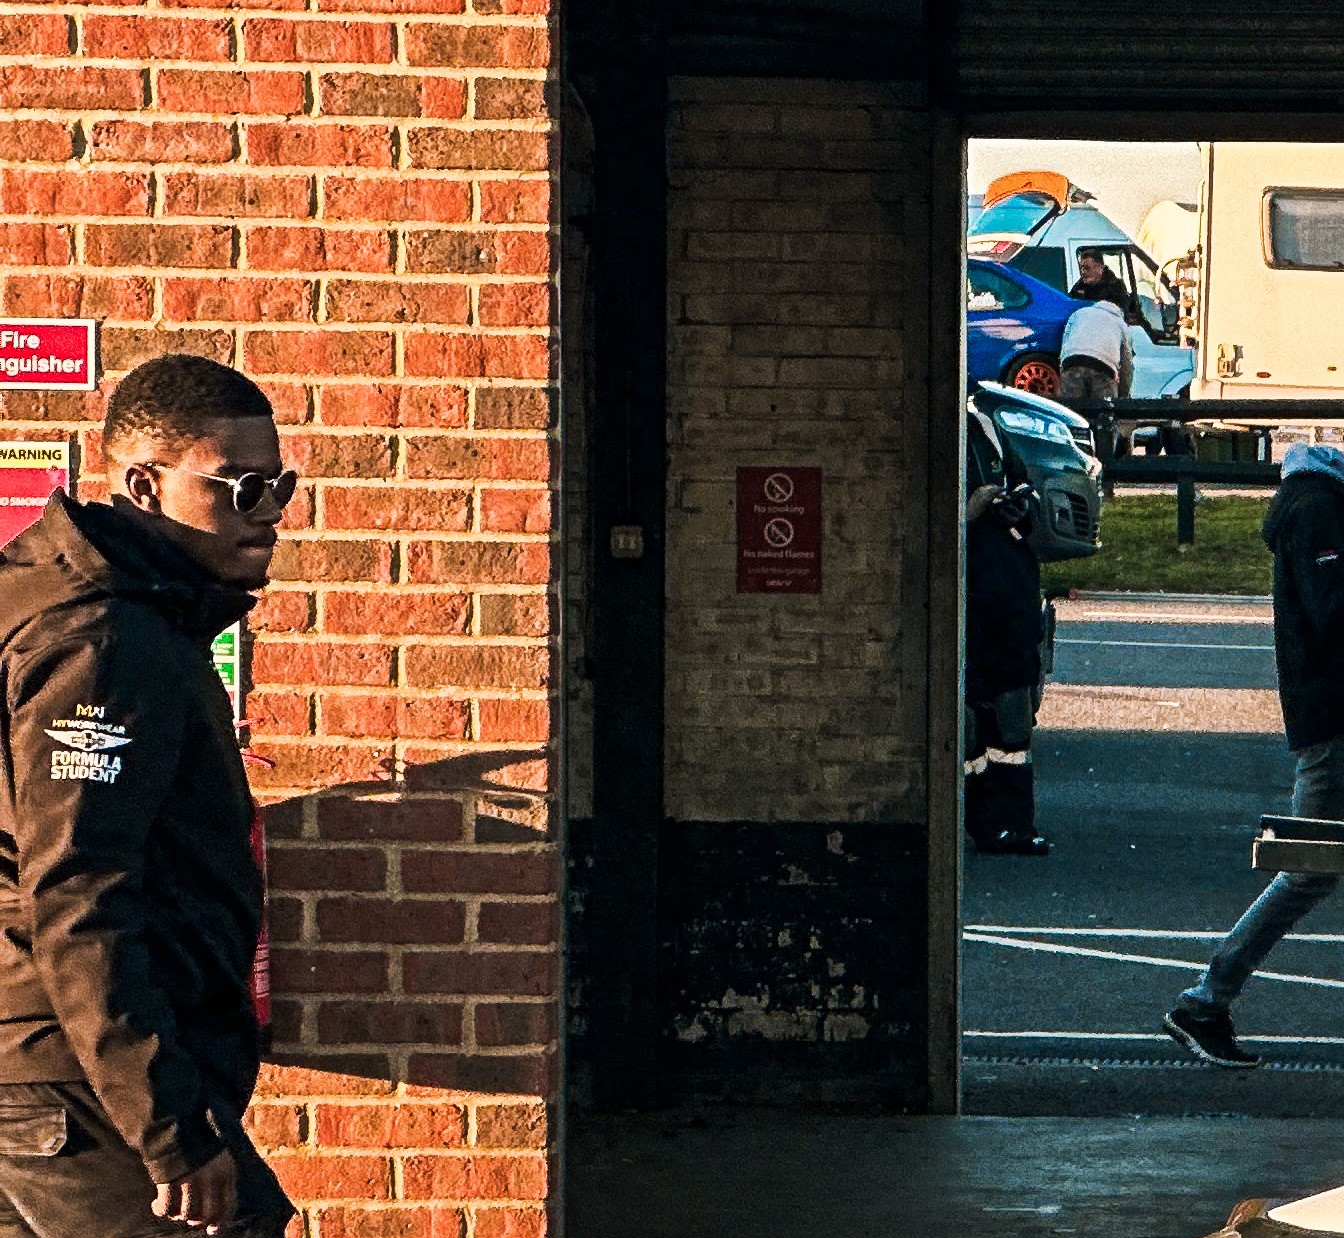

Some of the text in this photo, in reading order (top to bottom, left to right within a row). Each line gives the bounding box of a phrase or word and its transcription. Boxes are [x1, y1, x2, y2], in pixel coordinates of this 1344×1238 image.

[1, 330, 41, 349] Fire
[51, 750, 121, 771] FORMULA
[50, 764, 121, 784] STUDENT
